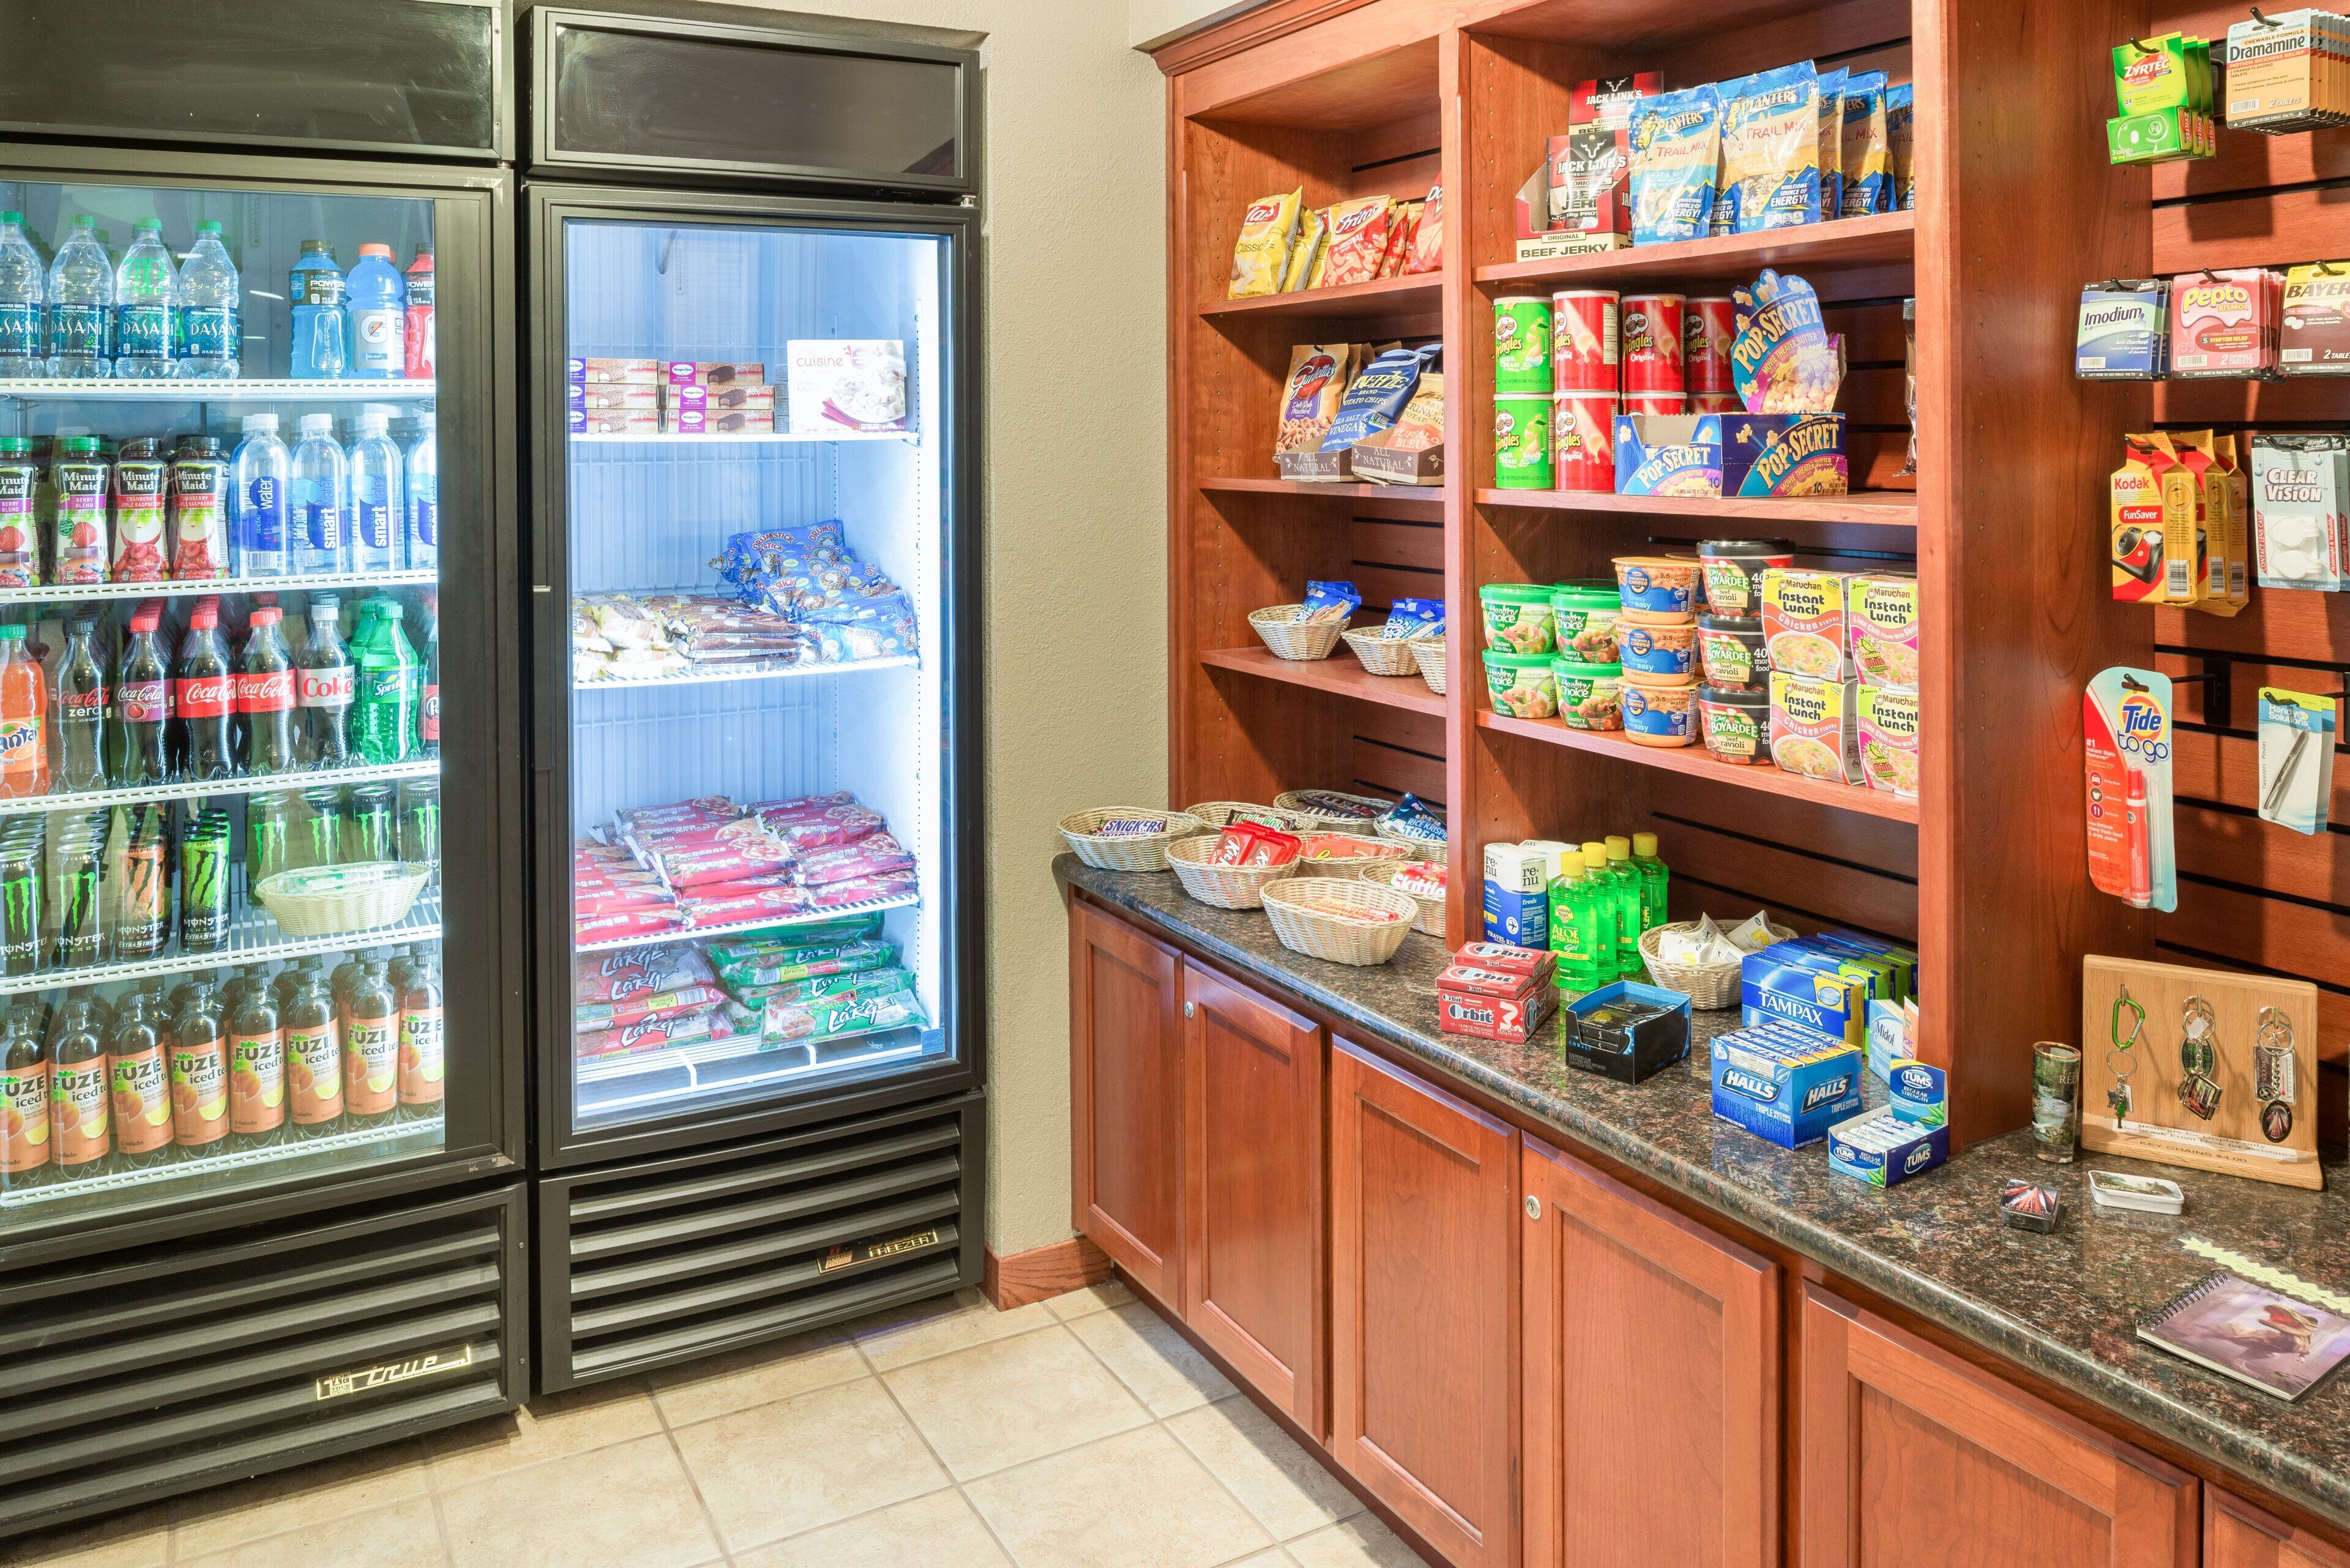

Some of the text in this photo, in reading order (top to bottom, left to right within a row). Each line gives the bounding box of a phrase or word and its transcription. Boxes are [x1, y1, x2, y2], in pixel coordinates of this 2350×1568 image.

[2244, 29, 2304, 45] CHEWABLE FORMULA
[2230, 35, 2308, 61] Dramamine
[2253, 54, 2284, 65] SICKNESS
[2285, 50, 2307, 58] RELIEF
[2124, 59, 2170, 79] ZYRTEC
[1742, 90, 1797, 114] PLANTERS
[2269, 97, 2300, 108] 2 TABLETS
[1746, 121, 1807, 140] TRAIL MIX
[1557, 155, 1627, 174] JACK LINK'S
[1770, 192, 1808, 208] ENERGY!
[1335, 204, 1378, 234] Fritos
[1236, 243, 1264, 254] Classic
[1340, 235, 1364, 248] ORIGINAL
[1521, 244, 1608, 258] BEEF JERKY
[2183, 285, 2249, 313] Pepto
[2218, 303, 2249, 312] BISMOL
[2085, 305, 2143, 326] Imodium
[51, 318, 102, 336] DASANI
[124, 319, 174, 338] DASANI
[1623, 334, 1654, 361] Pringles
[1762, 333, 1818, 376] MOVIE THEATER BUTTER
[796, 356, 844, 367] cuisine
[1630, 353, 1655, 362] Original
[1365, 397, 1388, 405] CHIPS
[1334, 416, 1344, 425] SEA
[1329, 424, 1367, 436] VINEGAR
[1395, 438, 1425, 449] BLEU
[1374, 448, 1388, 457] ALL
[1363, 456, 1404, 470] NATURAL
[64, 472, 105, 482] Minute
[122, 471, 160, 480] Minute
[2267, 468, 2317, 485] CLEAR
[70, 481, 102, 491] Maid
[127, 480, 156, 490] Maid
[2114, 477, 2150, 490] Kodak
[261, 478, 273, 510] water
[2124, 510, 2158, 519] FunSaver
[371, 506, 387, 547] smart
[752, 532, 795, 550] DRUMSTICK
[1707, 575, 1750, 588] BOYARDEE
[1786, 579, 1822, 591] Maruchan
[1778, 590, 1825, 605] Instant
[1490, 605, 1518, 616] Healthy
[1783, 602, 1820, 615] Lunch
[1488, 613, 1516, 622] Choice
[1778, 613, 1840, 630] Chicken Flavor
[118, 685, 163, 701] Coca-Cola
[304, 677, 353, 698] Coke
[69, 706, 100, 717] zero
[2269, 704, 2298, 715] Handy
[2122, 704, 2162, 734] Tide
[2268, 712, 2308, 727] Solutions
[2086, 739, 2095, 747] #1
[2117, 730, 2169, 764] to go
[1105, 819, 1163, 833] SNICKERS
[1523, 876, 1539, 886] nu
[1487, 930, 1506, 943] TRAVEL
[1552, 924, 1580, 939] ALOE
[56, 944, 99, 954] ENERGY
[1442, 994, 1463, 1003] Orbit
[1449, 1004, 1496, 1024] Orbit
[1758, 991, 1823, 1026] TAMPAX
[401, 1018, 442, 1034] FUZE
[1876, 1024, 1895, 1046] Midol
[362, 1043, 386, 1056] iced
[1569, 1040, 1591, 1051] COBALT
[173, 1053, 218, 1073] FUZE
[190, 1070, 214, 1084] iced
[1903, 1070, 1933, 1089] TUMS
[1726, 1070, 1777, 1099] HALLS
[1901, 1089, 1928, 1103] STRENGTH
[1903, 1086, 1928, 1098] REGULAR
[1755, 1102, 1774, 1118] TRIPLE
[1774, 1114, 1791, 1124] ACTION
[2166, 1146, 2212, 1157] CHAINS
[2216, 1154, 2247, 1163] $4.00
[870, 1236, 929, 1258] FREEZER
